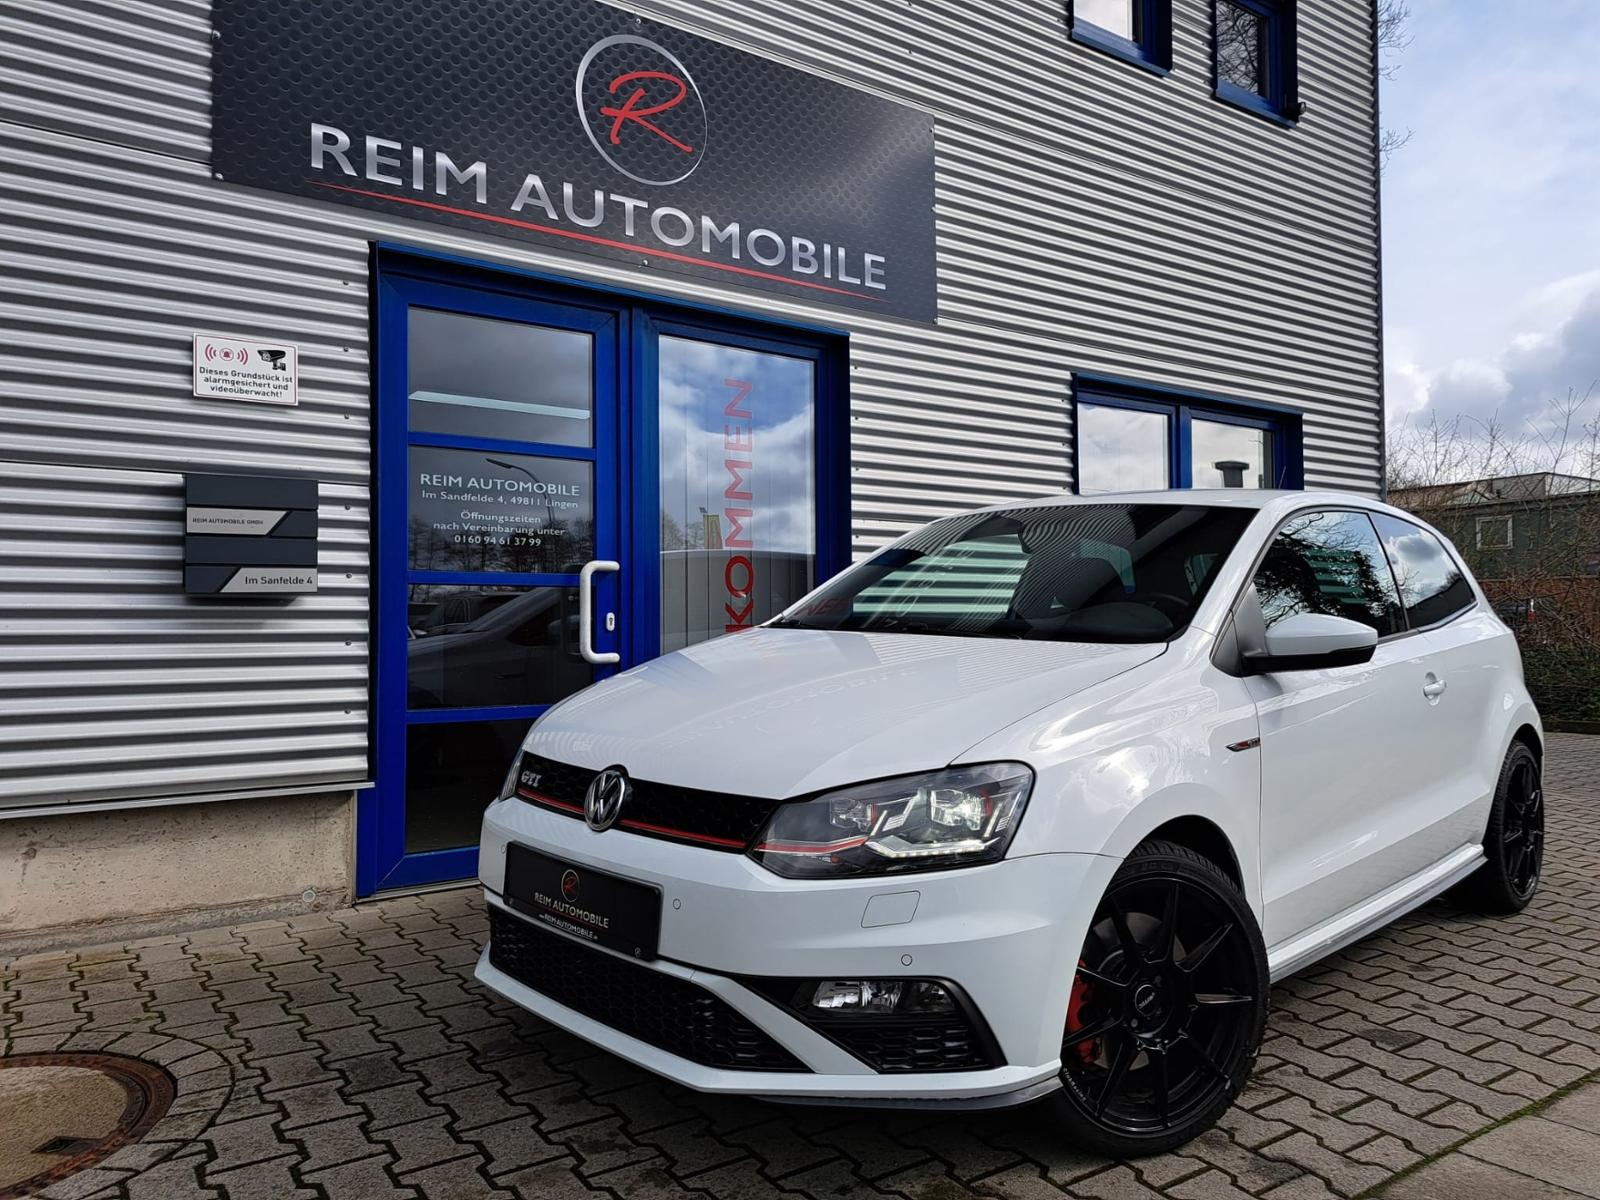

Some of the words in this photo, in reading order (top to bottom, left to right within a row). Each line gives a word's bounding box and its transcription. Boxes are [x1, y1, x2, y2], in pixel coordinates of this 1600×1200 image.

[600, 71, 693, 152] R
[310, 122, 488, 204] REIM
[510, 174, 887, 291] AUTOMOBILE
[199, 366, 229, 377] Dieses
[230, 370, 280, 382] Grundstück
[203, 375, 271, 389] alarmgesichert
[273, 383, 289, 391] und
[210, 384, 283, 398] videoüberwacht!
[420, 473, 462, 488] REIM
[467, 477, 580, 497] AUTOMOBILE
[422, 490, 437, 499] Im
[440, 491, 494, 504] Sandfelde
[510, 497, 541, 507] 49811
[545, 499, 579, 510] Lingen
[460, 509, 541, 524] Öffnungszeiten
[433, 521, 460, 531] nach
[461, 523, 535, 537] Vereinbarung
[537, 526, 566, 537] unter
[454, 534, 481, 544] 0160
[483, 535, 496, 545] 94
[499, 536, 511, 546] 61
[514, 537, 526, 546] 37
[529, 538, 542, 547] 99
[245, 576, 258, 585] Im
[260, 576, 305, 585] Sanfelde
[306, 576, 313, 585] 4
[521, 770, 543, 788] GTI
[534, 891, 552, 907] REIM
[552, 900, 609, 930] AUTOMOBILE
